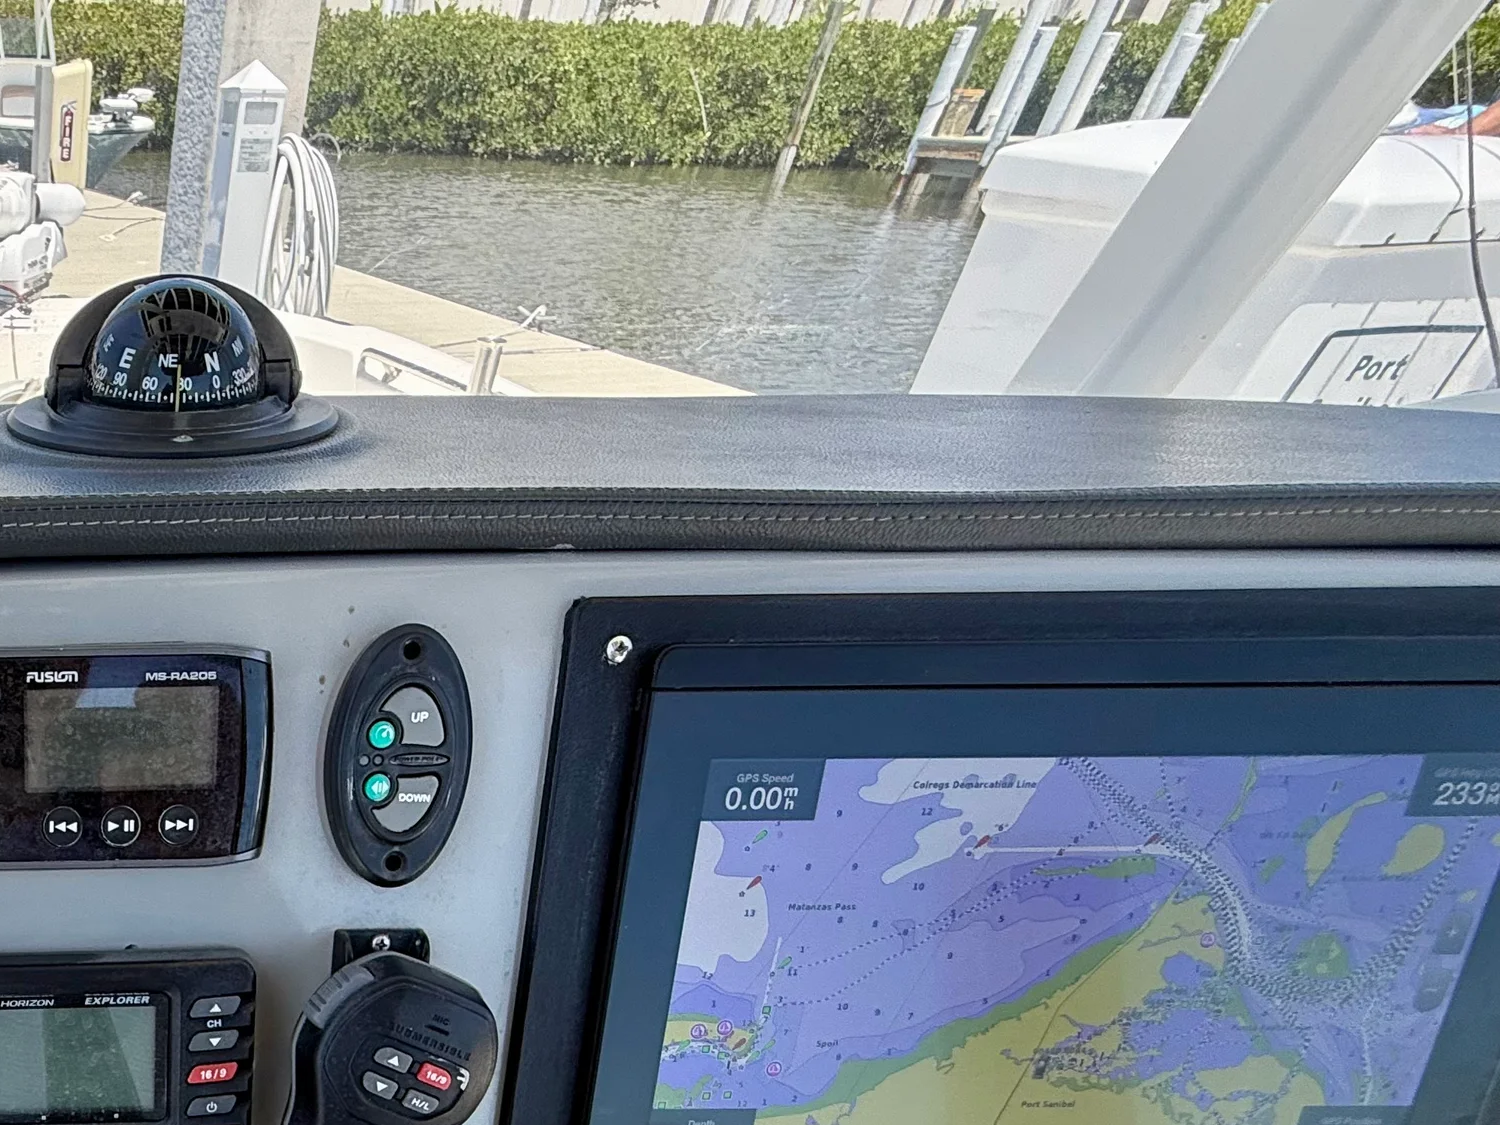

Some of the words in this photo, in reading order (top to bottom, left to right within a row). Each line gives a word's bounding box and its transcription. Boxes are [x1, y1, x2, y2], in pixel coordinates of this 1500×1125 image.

[62, 115, 72, 159] FIRE
[118, 347, 137, 369] E
[158, 353, 179, 368] NE
[204, 351, 220, 373] N
[1345, 353, 1411, 382] Port
[113, 371, 128, 387] 90
[141, 377, 158, 391] 60
[212, 375, 221, 389] 0
[26, 671, 78, 683] FUSION
[145, 671, 217, 682] MS-RA205
[411, 711, 429, 723] UP
[736, 773, 759, 783] GPS
[761, 773, 794, 785] Speed
[913, 780, 949, 790] Colregs
[952, 780, 1013, 790] Demarcation
[1016, 779, 1037, 789] Line
[398, 793, 431, 803] DOWN
[725, 786, 783, 811] 0.00
[1432, 781, 1488, 806] 233
[921, 807, 933, 816] 12
[912, 882, 925, 891] 10
[788, 903, 832, 911] Matanzas
[835, 902, 857, 911] Pass
[743, 909, 756, 917] 13
[0, 999, 55, 1008] HORIZON
[84, 995, 150, 1006] EXPLORER
[837, 1002, 849, 1011] 10
[207, 1019, 222, 1028] CH
[816, 1039, 839, 1048] Spoil
[426, 1070, 448, 1085] 16/9
[411, 1097, 430, 1111] H/L
[1021, 1100, 1040, 1108] Port
[1042, 1100, 1076, 1108] Sanibel
